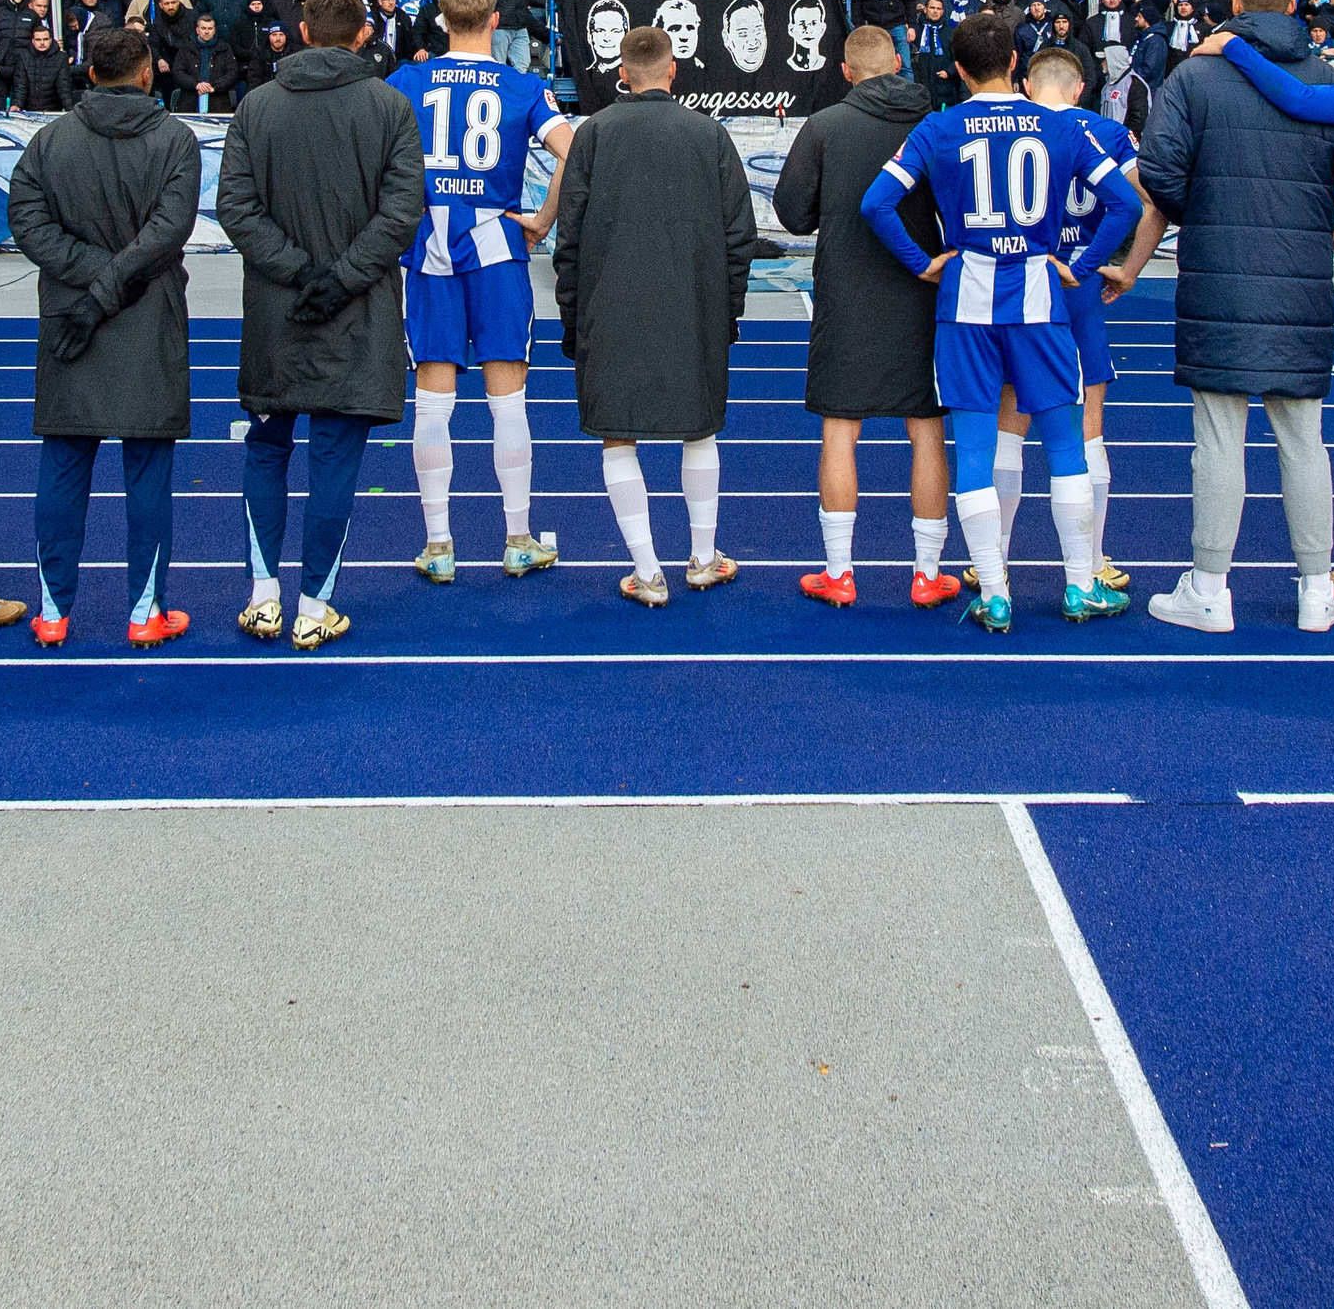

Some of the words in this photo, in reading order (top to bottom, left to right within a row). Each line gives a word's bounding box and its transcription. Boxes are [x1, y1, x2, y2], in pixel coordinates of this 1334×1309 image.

[431, 69, 477, 84] HERTHA
[478, 70, 501, 87] BSC
[423, 86, 502, 172] 18
[964, 115, 1017, 134] HERTHA
[1016, 115, 1042, 132] BSC
[434, 177, 485, 195] SCHULER
[959, 136, 1050, 229] 10
[991, 235, 1028, 254] MAZA
